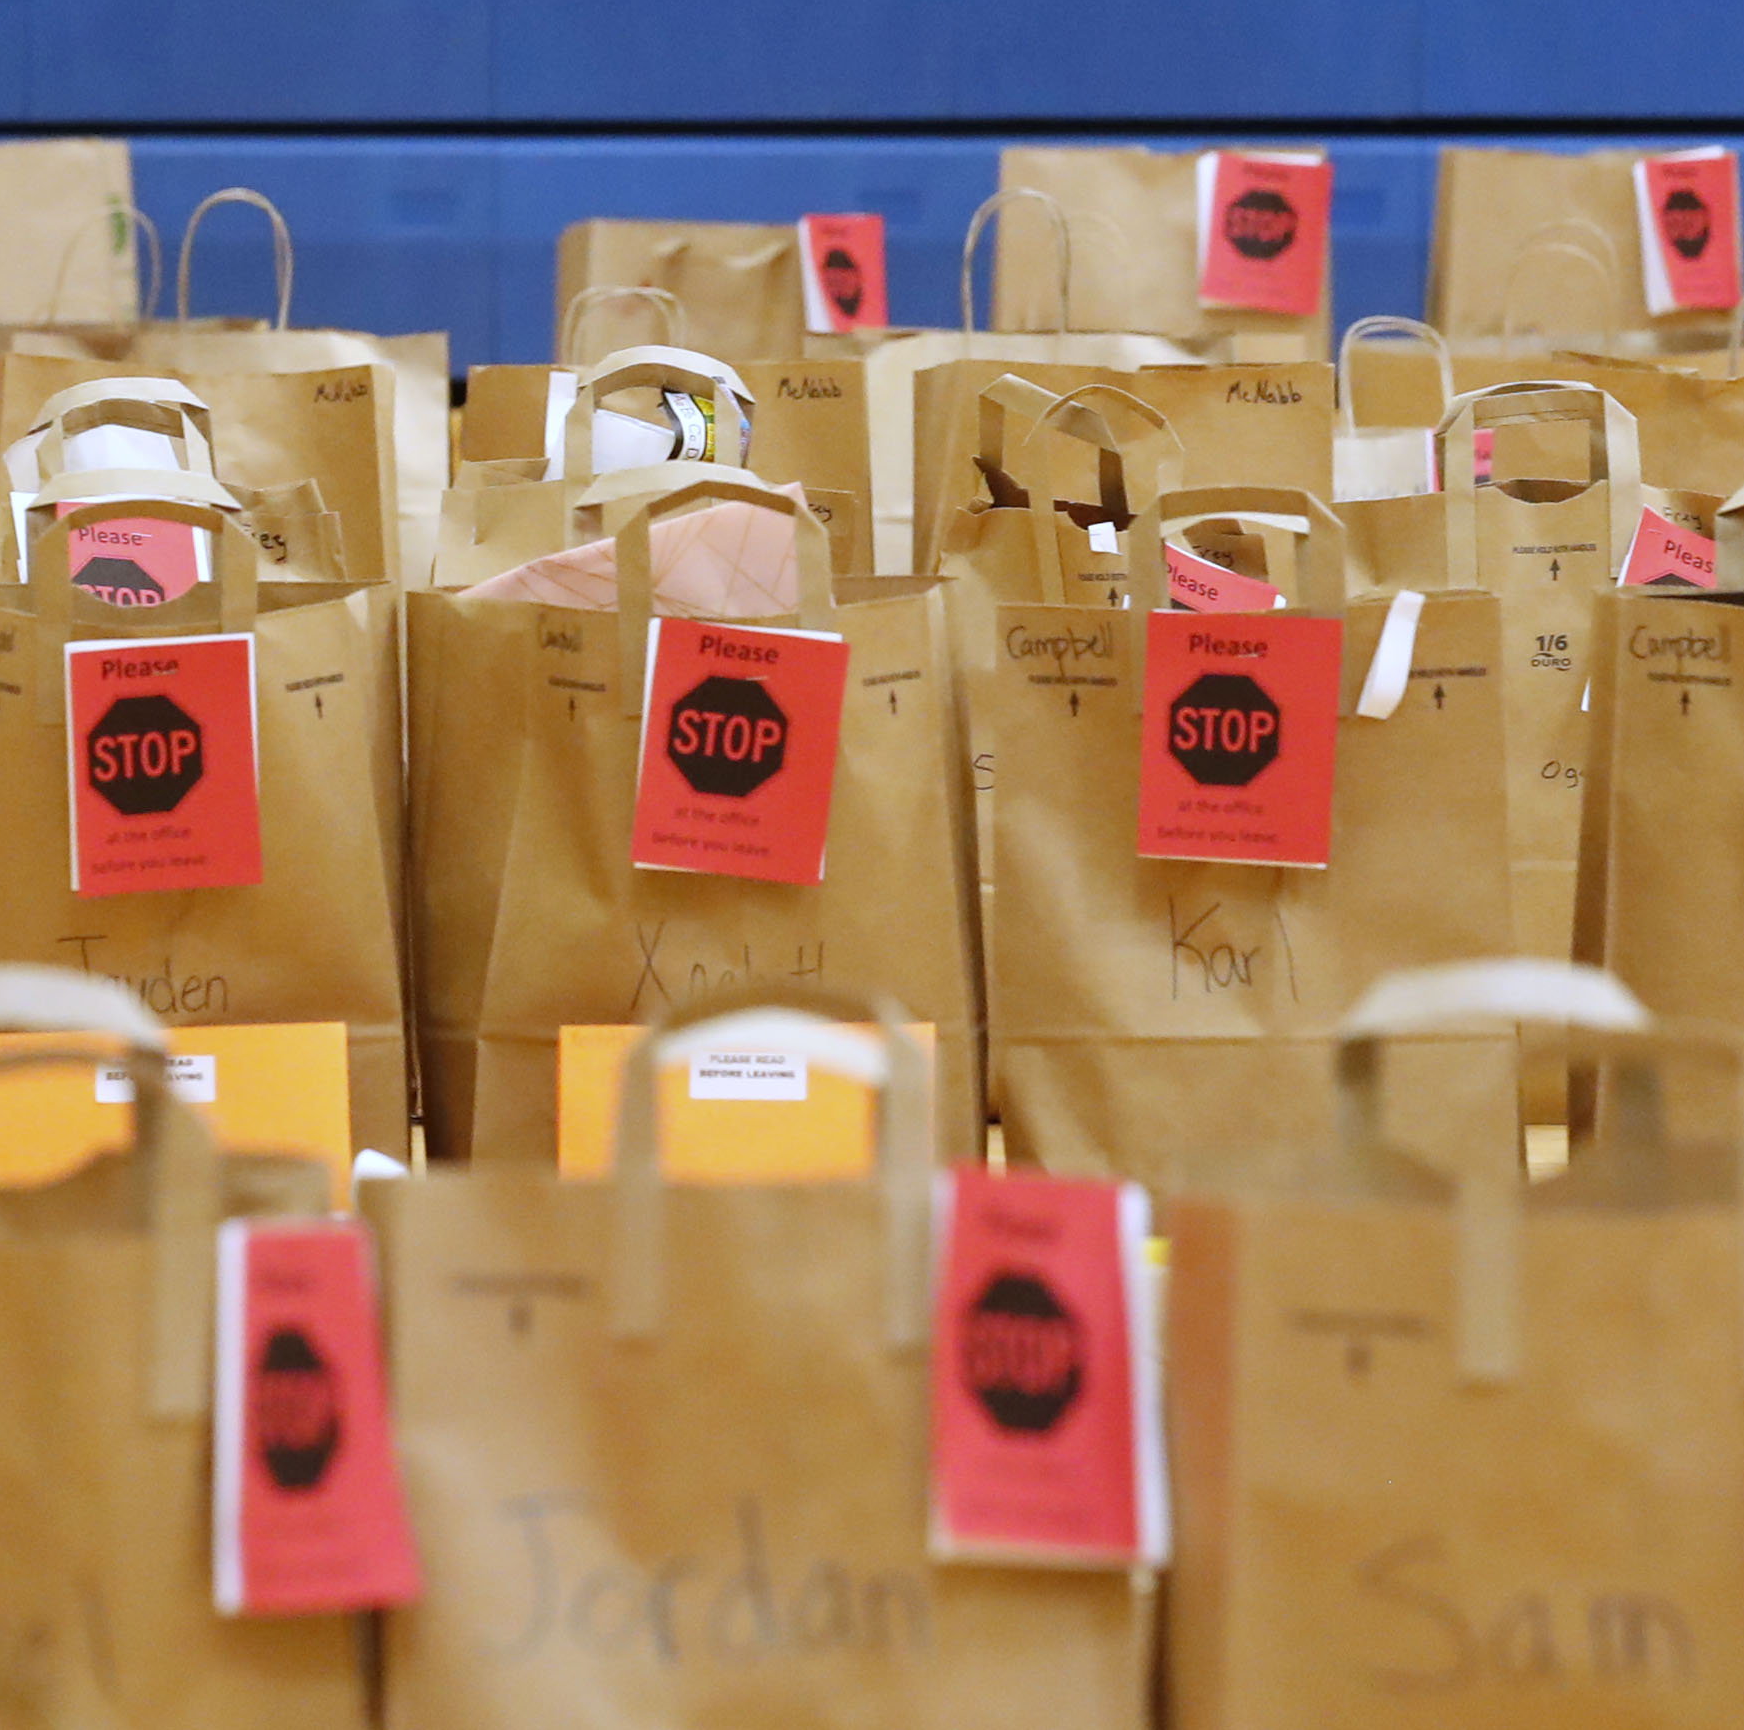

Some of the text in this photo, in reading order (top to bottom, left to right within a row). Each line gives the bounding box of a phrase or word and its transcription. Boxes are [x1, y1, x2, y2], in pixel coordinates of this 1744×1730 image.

[1225, 378, 1303, 407] McNabb
[77, 527, 143, 548] Please
[1664, 538, 1715, 575] Pleas
[697, 632, 780, 667] Please
[1005, 621, 1113, 678] Campbell
[1188, 632, 1269, 660] Please
[1535, 634, 1569, 652] 1/6
[100, 653, 180, 682] Please
[1530, 656, 1572, 669] DURO
[671, 706, 783, 762] STOP
[1172, 703, 1275, 755] STOP
[92, 728, 199, 783] STOP
[1169, 893, 1300, 1006] Karl
[698, 1068, 796, 1080] BEFORE LEAVING
[709, 1053, 786, 1065] PLEASE READ
[483, 1486, 933, 1668] Jordan
[1353, 1532, 1700, 1698] Sam
